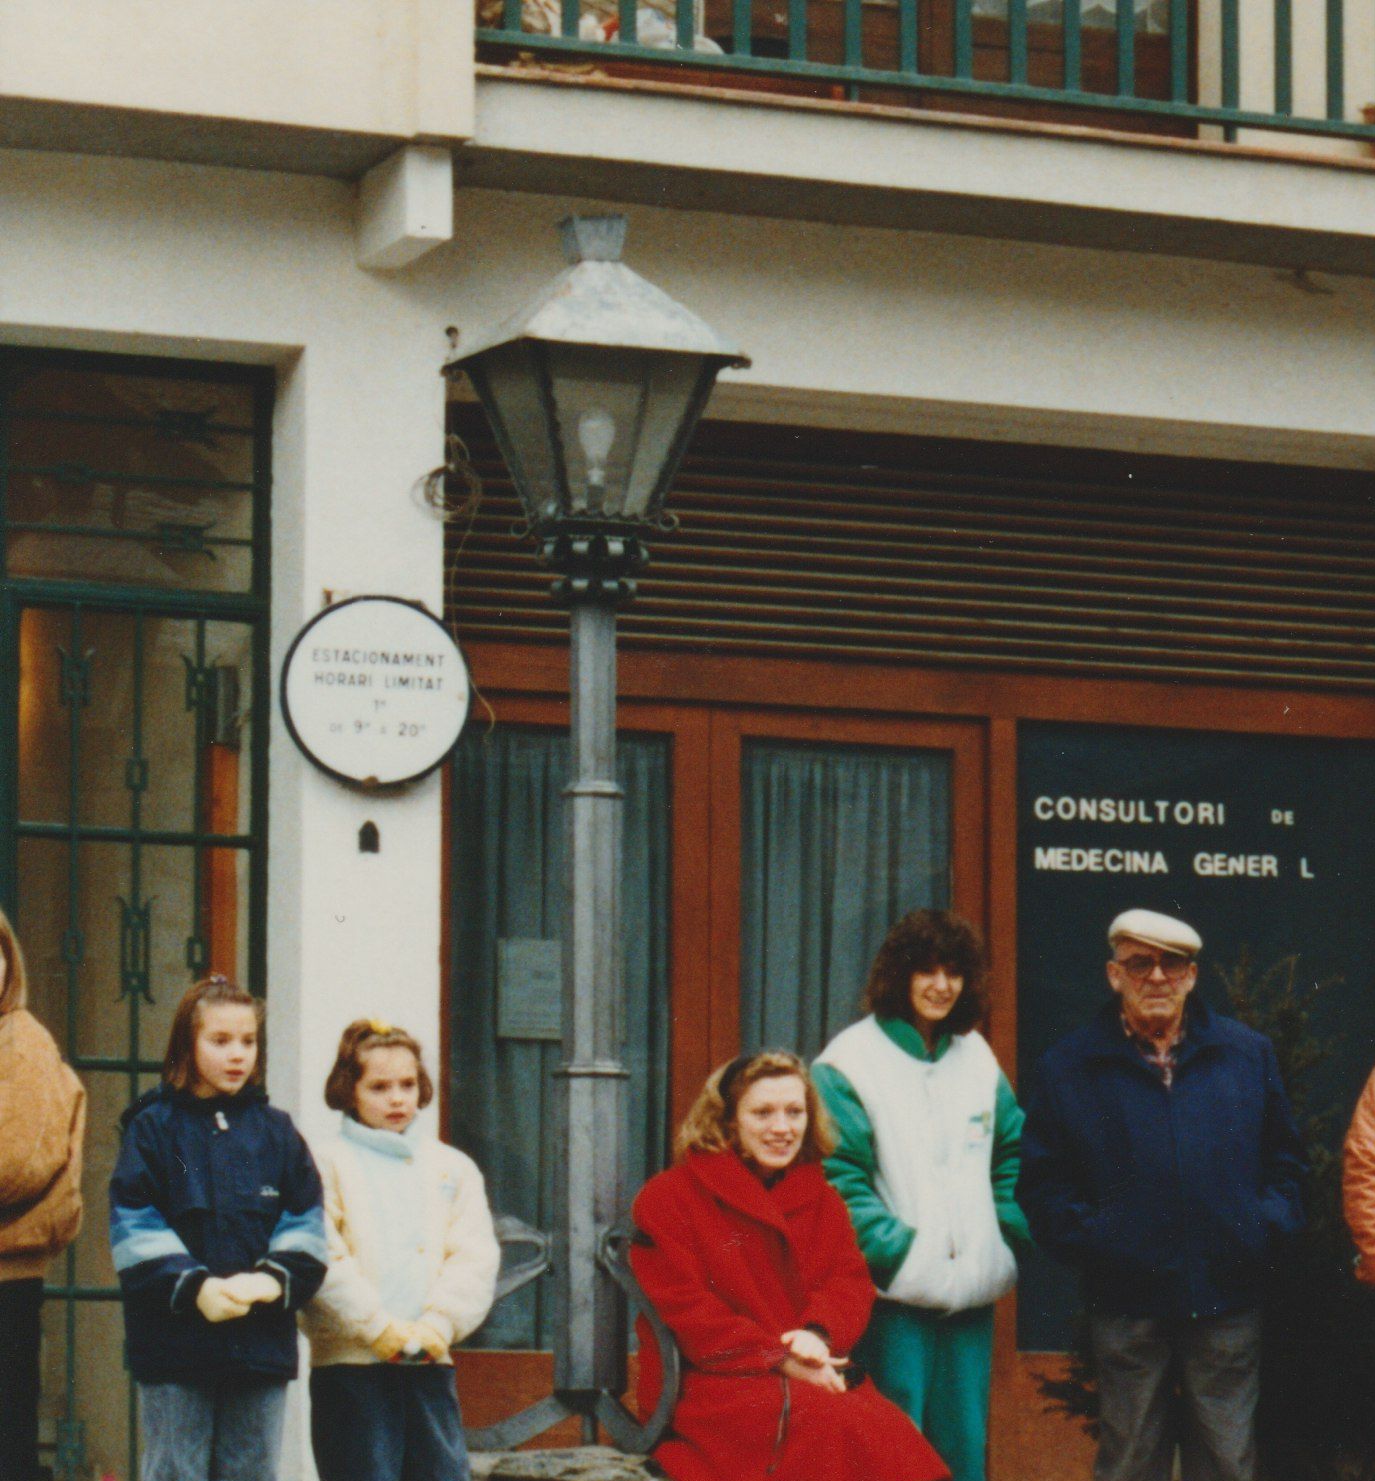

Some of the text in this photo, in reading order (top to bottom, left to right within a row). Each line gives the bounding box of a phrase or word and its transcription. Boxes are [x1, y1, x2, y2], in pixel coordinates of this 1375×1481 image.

[312, 648, 445, 667] ESTACIONAMENT
[314, 671, 443, 691] HORARI LIMITAT
[1034, 796, 1295, 826] CONSULTORI DE
[1034, 846, 1169, 875] MEDECINA
